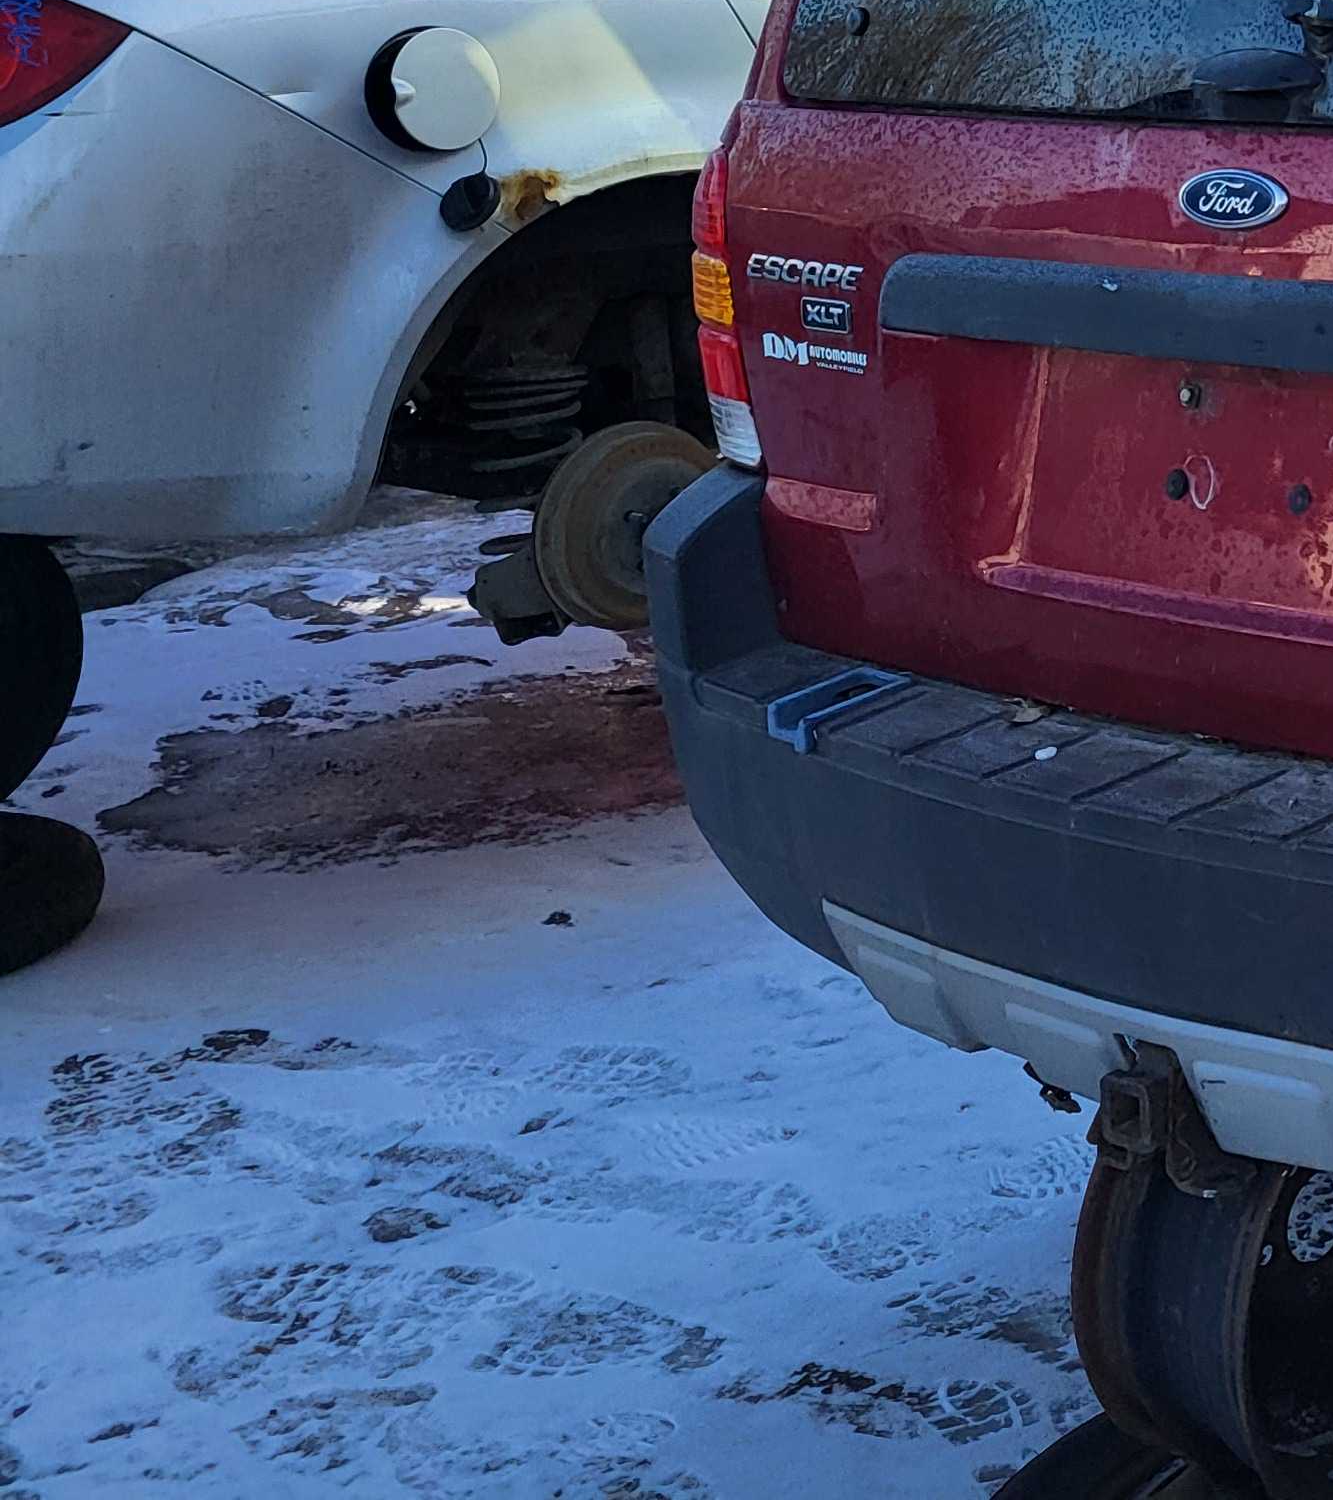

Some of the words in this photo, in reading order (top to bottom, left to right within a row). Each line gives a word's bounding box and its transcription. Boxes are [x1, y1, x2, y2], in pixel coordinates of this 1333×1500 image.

[1199, 179, 1258, 215] Ford
[747, 253, 863, 291] ESCAPE
[805, 303, 844, 326] XLT
[762, 332, 809, 366] DM
[809, 345, 867, 366] AUTOMOBILES
